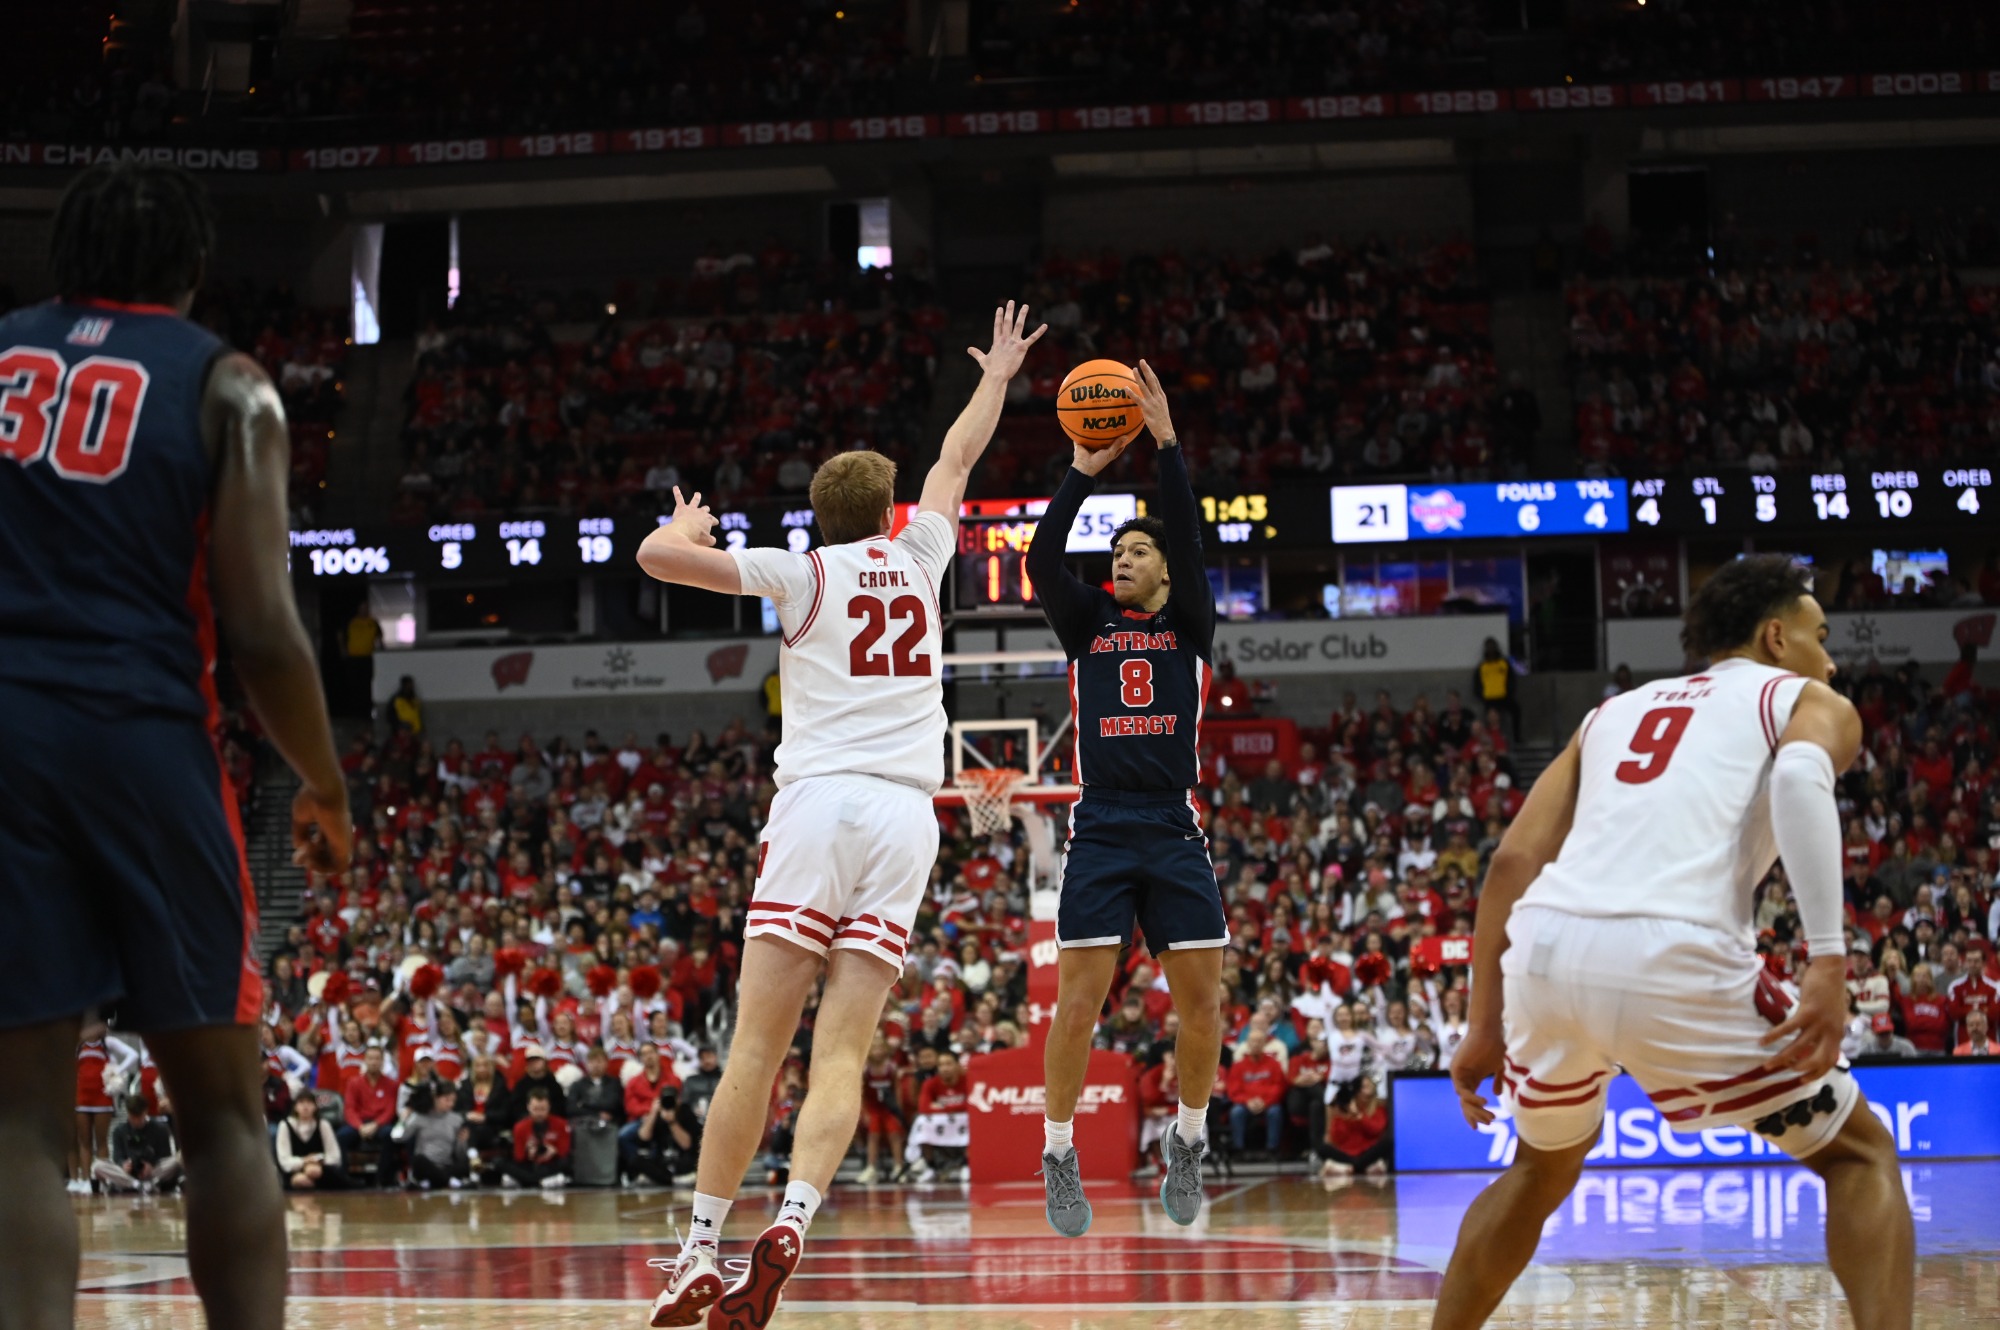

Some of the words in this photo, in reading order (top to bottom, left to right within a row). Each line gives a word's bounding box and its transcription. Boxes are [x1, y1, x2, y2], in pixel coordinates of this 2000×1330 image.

[1646, 80, 1725, 104] 1941
[1760, 75, 1842, 99] 1947
[1872, 72, 1962, 96] 2002
[1300, 95, 1384, 118] 1924
[1529, 85, 1614, 109] 1935
[961, 111, 1039, 134] 1918
[1073, 105, 1152, 128] 1921
[1185, 100, 1270, 124] 1923
[628, 127, 704, 150] 1913
[737, 122, 814, 145] 1914
[849, 116, 925, 139] 1916
[408, 139, 488, 162] 1908
[520, 132, 594, 156] 1912
[0, 144, 30, 162] N
[43, 144, 259, 169] CHAMPIONS
[302, 146, 379, 169] 1907
[0, 345, 150, 484] 30
[1082, 414, 1127, 430] NCAA
[1576, 480, 1614, 499] TOL
[1631, 479, 1666, 497] AST
[1692, 477, 1725, 495] STL
[1751, 475, 1776, 493] TO
[1810, 474, 1847, 492] REB
[1871, 471, 1919, 489] DREB
[1943, 469, 1992, 487] OREB
[1496, 482, 1557, 502] FOULS
[1956, 487, 1981, 515] 4
[1201, 495, 1268, 523] 1:43
[1358, 503, 1389, 526] 21
[1583, 501, 1608, 529] 4
[1636, 498, 1661, 526] 4
[1700, 497, 1717, 525] 1
[1755, 494, 1777, 522] 5
[1813, 492, 1850, 520] 14
[1875, 490, 1913, 518] 10
[578, 517, 614, 535] REB
[720, 513, 751, 531] STL
[781, 510, 814, 527] AST
[1077, 513, 1115, 537] 35
[1517, 503, 1541, 531] 6
[289, 527, 356, 547] THROWS
[428, 523, 476, 542] OREB
[499, 520, 546, 539] DREB
[725, 530, 748, 551] 2
[786, 527, 811, 552] 9
[1217, 523, 1252, 542] 1ST
[441, 543, 462, 569] 5
[506, 539, 541, 565] 14
[577, 535, 613, 563] 19
[310, 547, 390, 575] 100%
[859, 571, 909, 588] CROWL
[847, 594, 932, 676] 22
[1090, 631, 1178, 654] DETROIT
[1239, 637, 1315, 662] Solar
[1321, 633, 1388, 660] Club
[1119, 658, 1154, 708] 8
[1100, 714, 1178, 737] MERCY
[1615, 706, 1695, 785] 9
[987, 1084, 1124, 1104] MUEER
